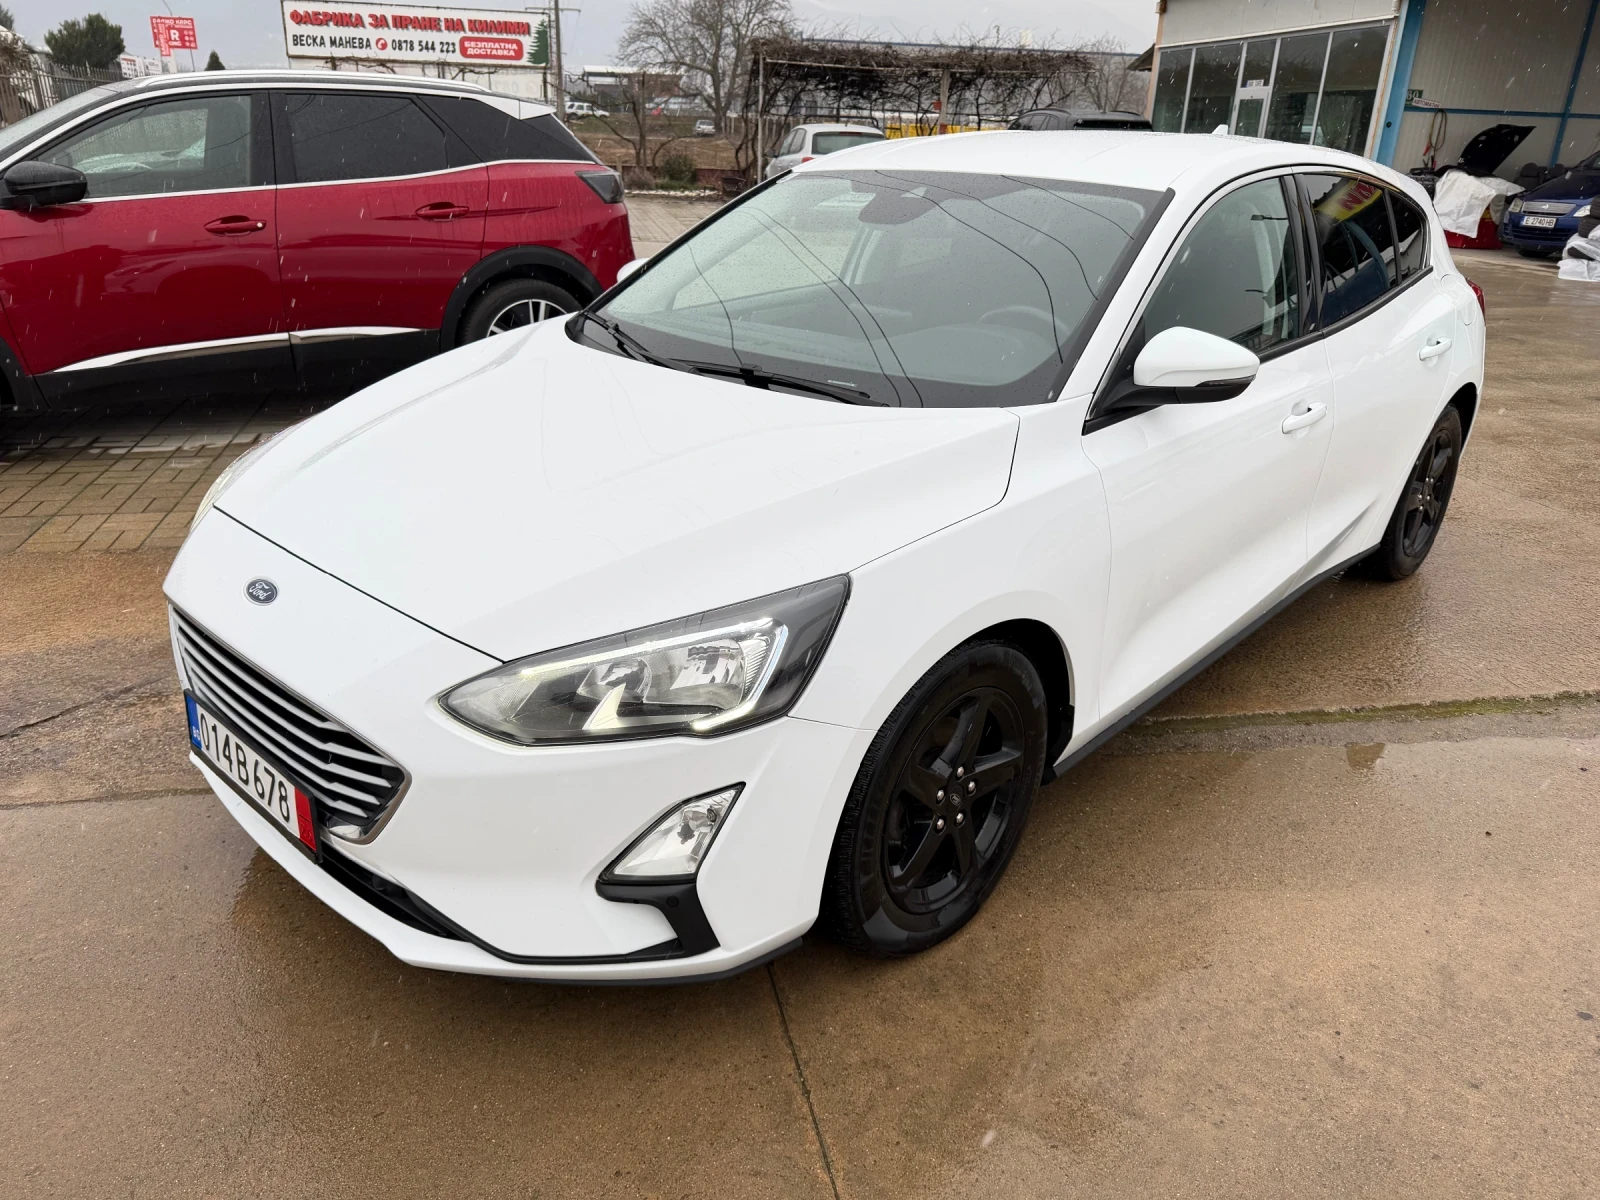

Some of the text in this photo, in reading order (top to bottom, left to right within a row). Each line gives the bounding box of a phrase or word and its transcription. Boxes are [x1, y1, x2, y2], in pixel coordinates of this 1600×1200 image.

[289, 10, 531, 36] ФАБРИКА ЗА ПРАНЕ НА КИЛИМИ
[292, 34, 456, 54] ВЕСКА МАНЕВА 0878 544 223
[464, 41, 518, 50] БЕЗПЛАТНА
[467, 47, 515, 56] ДОСТАВКА
[248, 581, 272, 600] Ford
